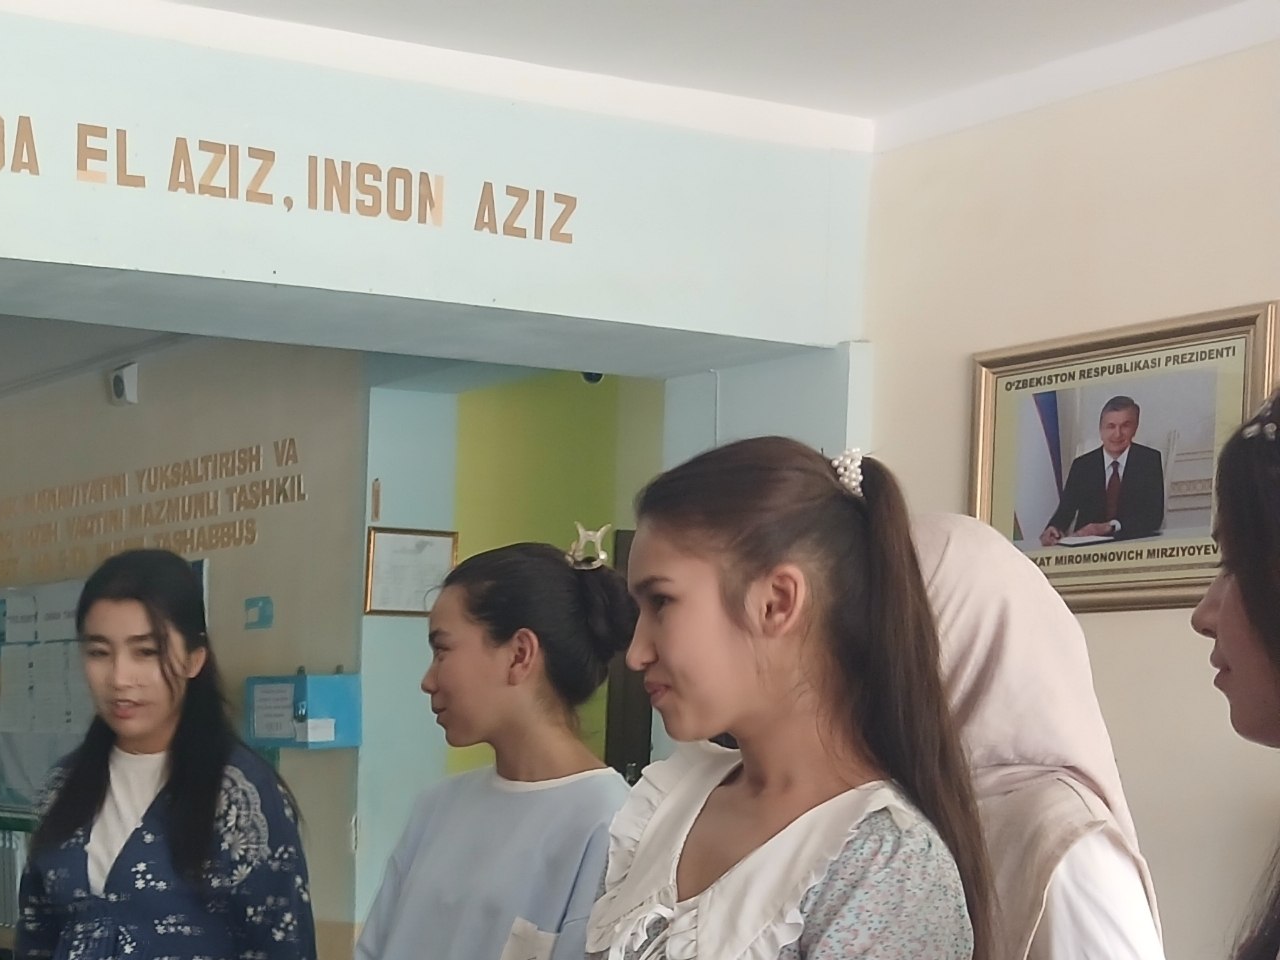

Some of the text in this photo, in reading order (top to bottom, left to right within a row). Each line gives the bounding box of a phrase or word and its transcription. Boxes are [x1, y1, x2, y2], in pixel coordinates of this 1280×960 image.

[76, 123, 146, 188] EL
[168, 136, 294, 212] AZIZ,
[307, 155, 444, 228] INSON
[473, 181, 578, 245] AZIZ
[1078, 357, 1162, 380] RESPUBLIKASI
[1164, 345, 1237, 367] PREZIDENTI
[135, 445, 263, 493] YUKSALTIRISH
[273, 438, 299, 467] VA
[226, 473, 309, 512] TASHKIL
[1054, 550, 1143, 565] MIROMONOVICH
[1146, 544, 1219, 559] MIRZIYOYEV
